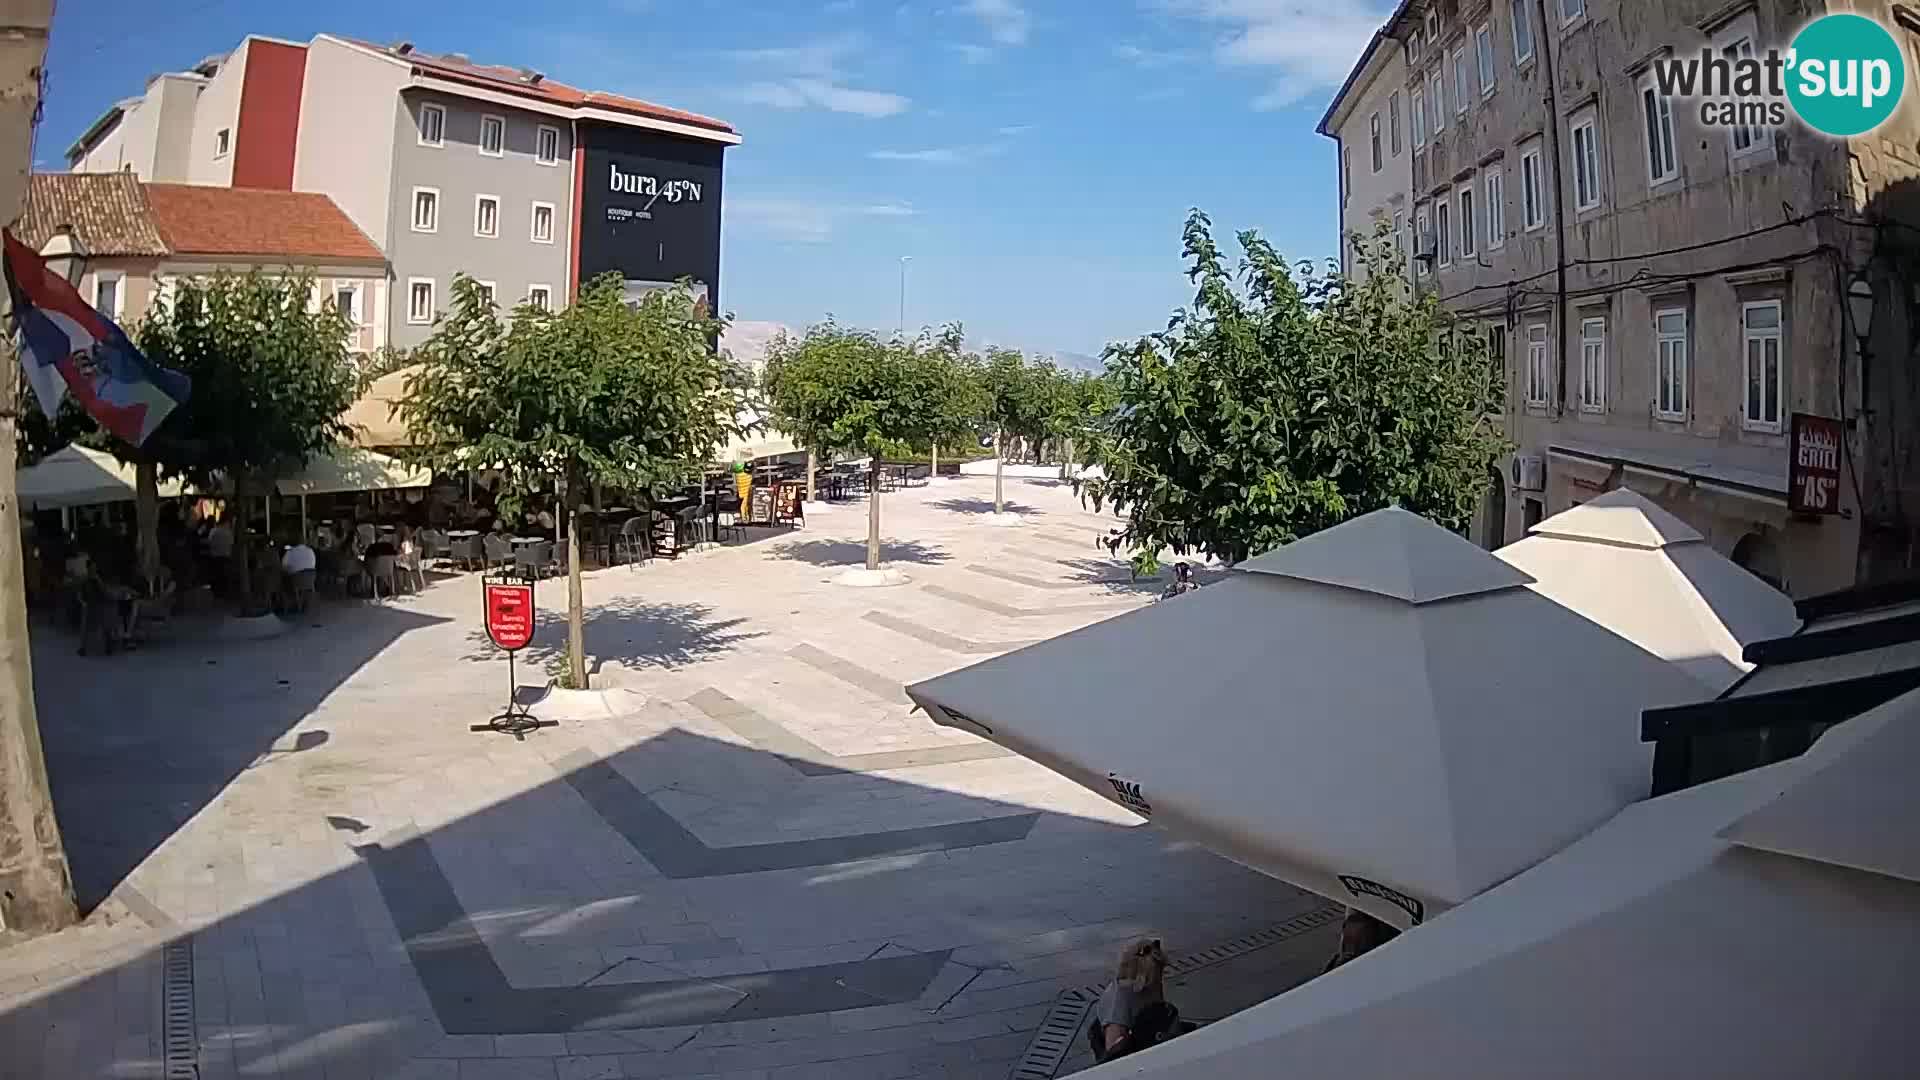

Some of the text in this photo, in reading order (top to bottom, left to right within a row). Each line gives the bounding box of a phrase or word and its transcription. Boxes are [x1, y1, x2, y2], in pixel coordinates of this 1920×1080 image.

[610, 164, 657, 196] bura
[1798, 447, 1838, 471] GRILL
[506, 577, 523, 585] BAR
